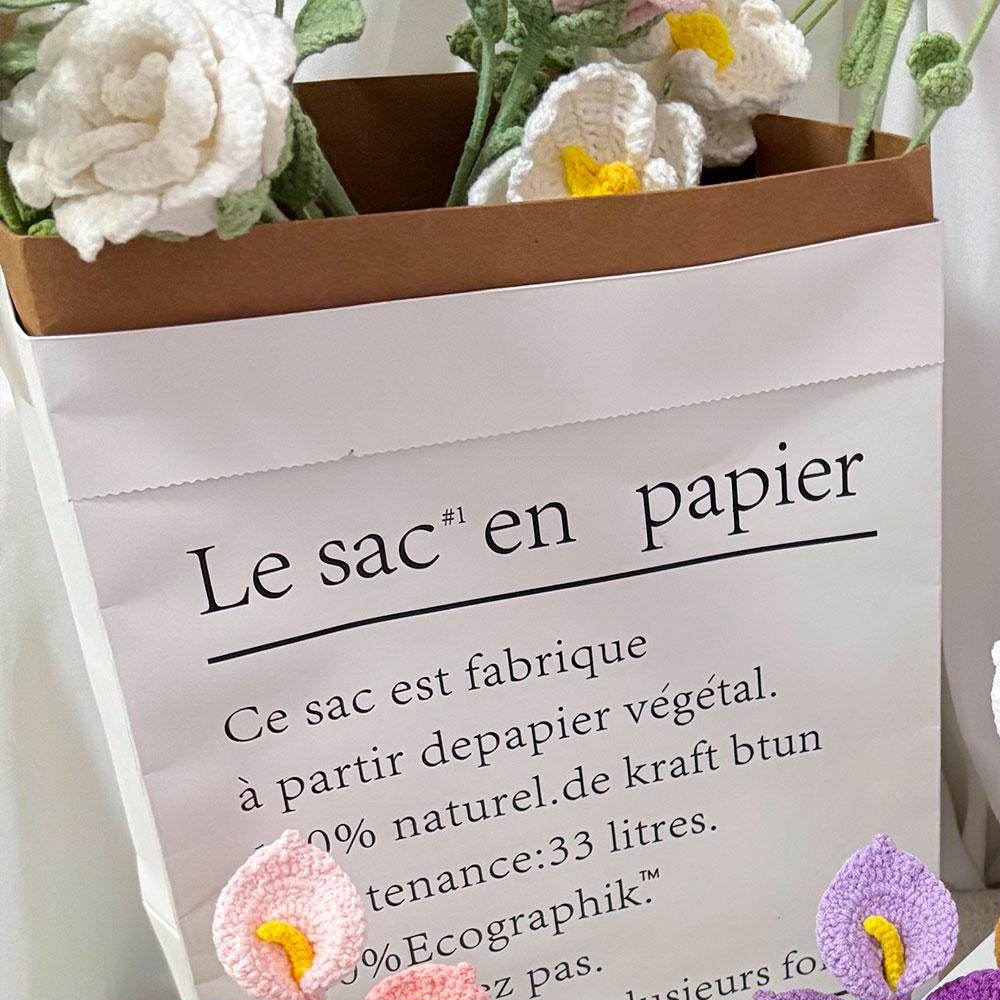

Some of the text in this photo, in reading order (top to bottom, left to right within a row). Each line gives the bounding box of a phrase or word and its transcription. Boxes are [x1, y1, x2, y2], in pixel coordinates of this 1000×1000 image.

[186, 442, 864, 615] Le sac #1 en papier
[224, 635, 648, 743] Ce sac est fabrique
[238, 665, 777, 814] à partir depapier végétal.
[622, 739, 720, 789] kraft
[729, 730, 823, 766] btun
[365, 813, 717, 912] tenance:33 litres.
[526, 955, 602, 1000] pas.
[782, 949, 828, 981] fo
